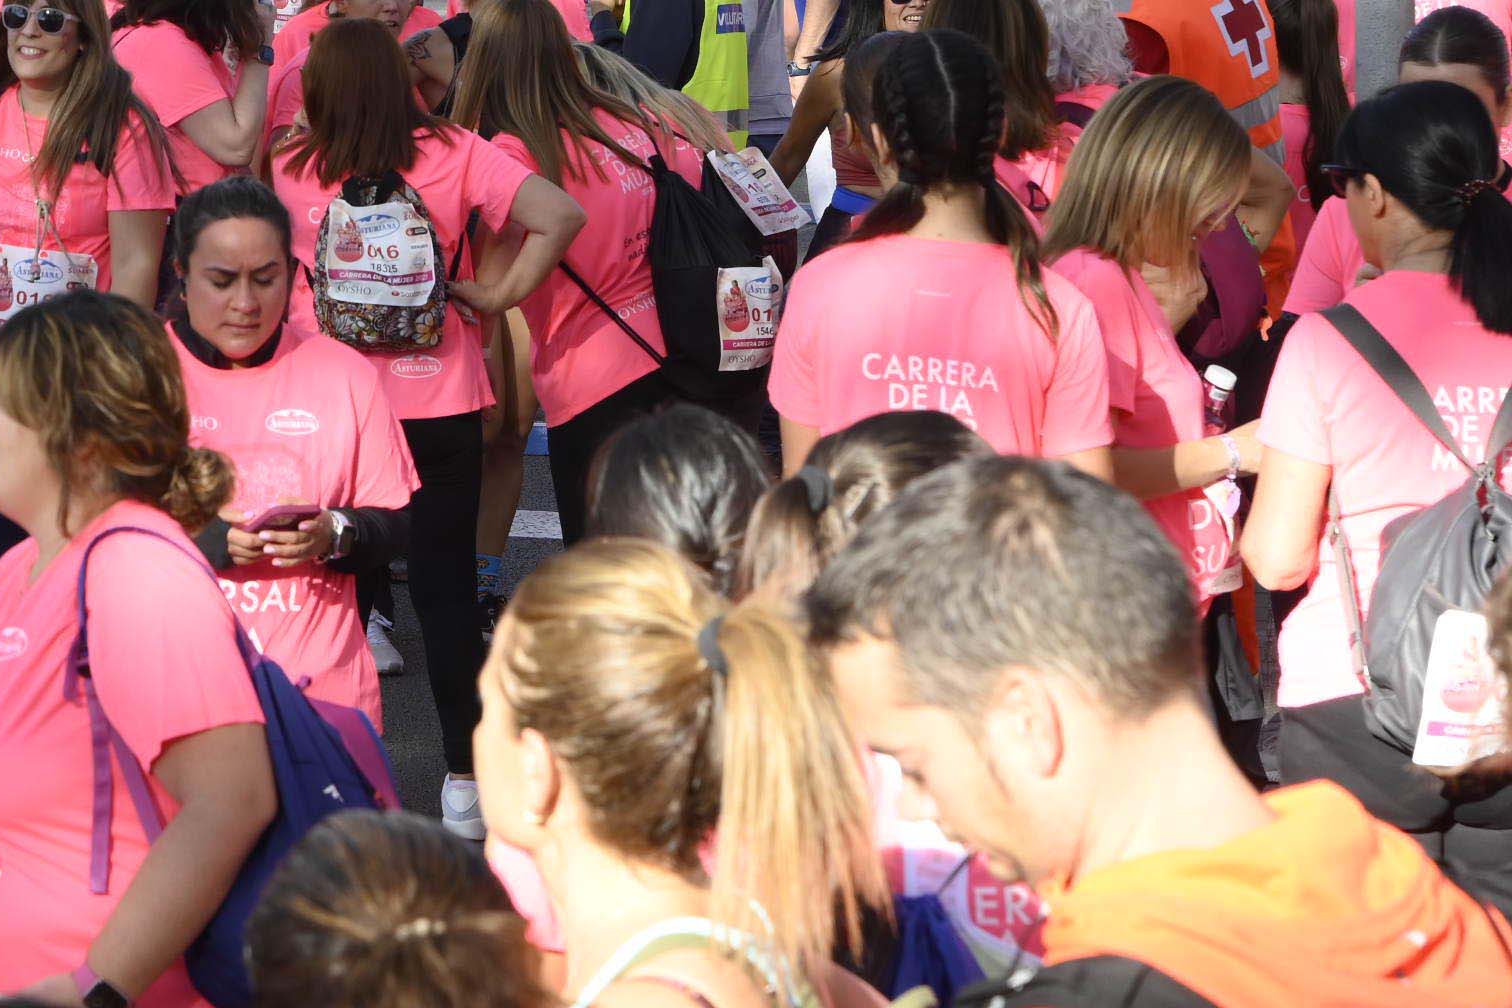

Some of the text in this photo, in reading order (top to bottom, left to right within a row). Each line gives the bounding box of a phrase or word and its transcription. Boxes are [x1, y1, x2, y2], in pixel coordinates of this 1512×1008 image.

[359, 223, 397, 234] STURIANA
[367, 244, 400, 260] 016
[339, 271, 372, 280] CARRERA
[337, 285, 372, 296] OYSHO
[751, 308, 774, 322] 01
[395, 363, 438, 373] ASTURIANA
[862, 351, 1000, 393] CARRERA
[887, 383, 974, 415] DE LA
